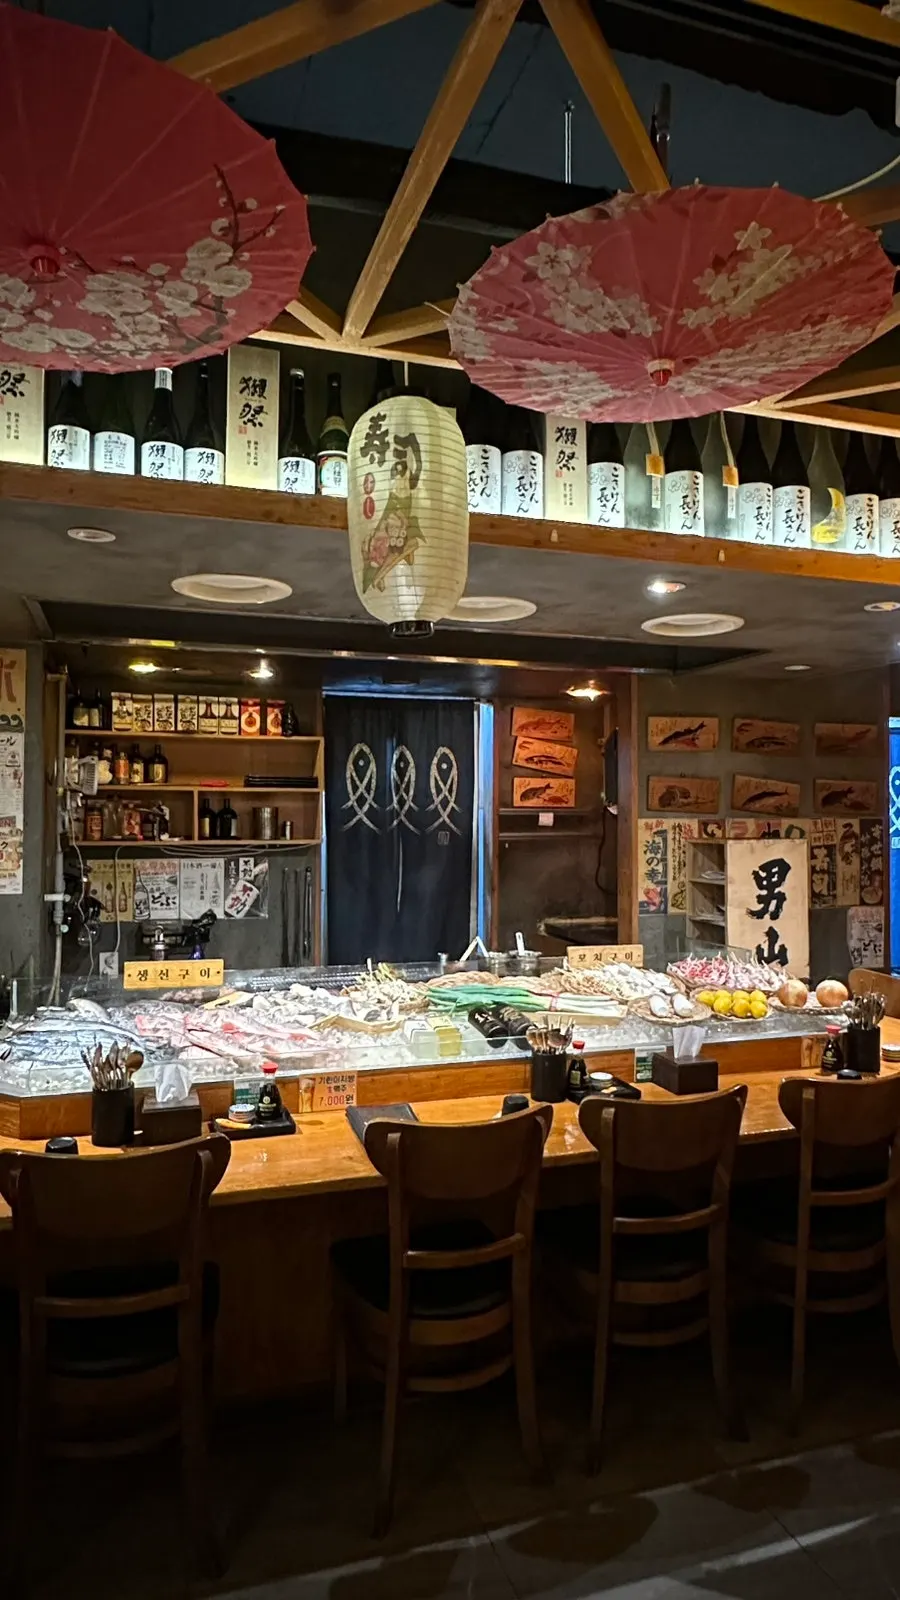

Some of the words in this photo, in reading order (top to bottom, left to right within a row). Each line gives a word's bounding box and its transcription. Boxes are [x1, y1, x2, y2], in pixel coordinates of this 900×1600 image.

[239, 376, 268, 427] 獺祭
[360, 412, 423, 490] 寿司
[555, 426, 579, 471] 獺祭
[643, 840, 662, 883] 海の幸
[746, 858, 791, 967] 男山
[136, 967, 211, 981] 생선구이
